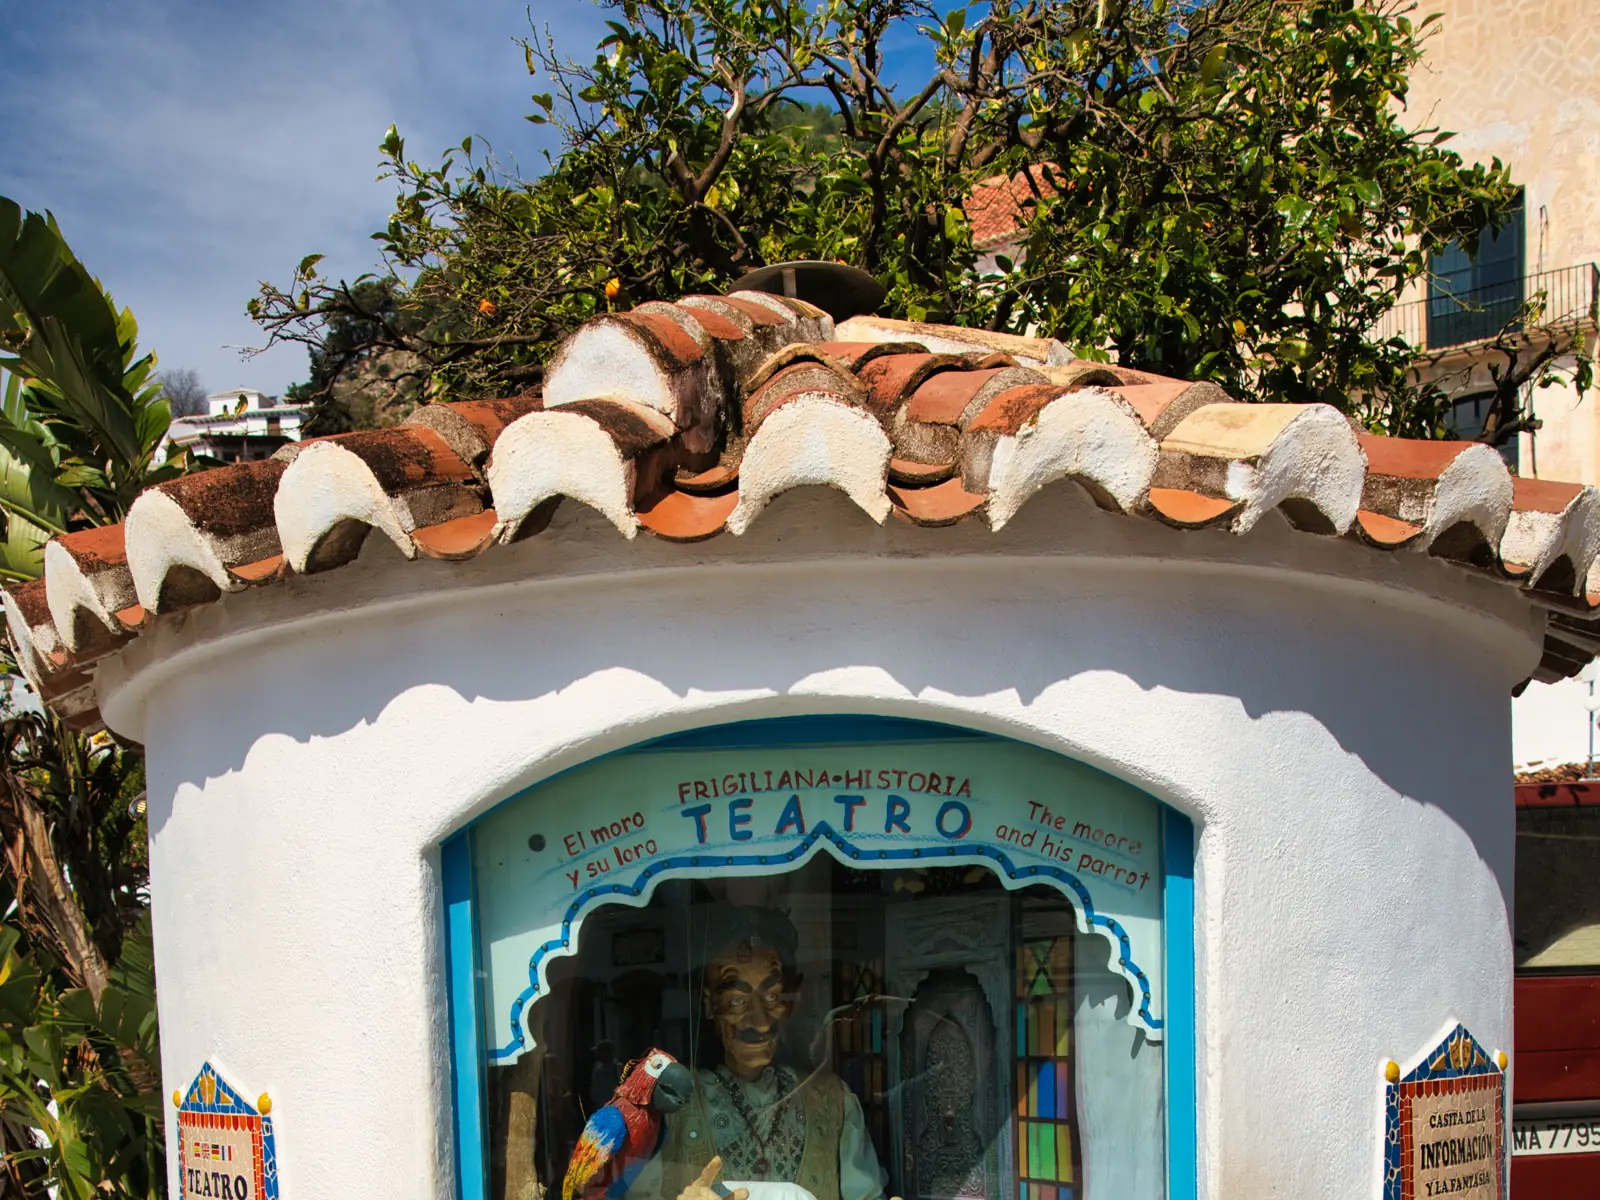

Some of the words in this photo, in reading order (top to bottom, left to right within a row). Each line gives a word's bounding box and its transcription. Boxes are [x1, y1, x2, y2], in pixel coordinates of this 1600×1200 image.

[563, 831, 587, 857] El
[591, 811, 645, 845] moro
[681, 795, 973, 844] TEATRO
[1028, 800, 1066, 830] The
[1073, 820, 1142, 856] moore
[566, 869, 579, 889] y
[587, 857, 611, 878] su
[613, 838, 658, 867] loro
[995, 824, 1037, 848] and
[1040, 833, 1073, 862] his
[1076, 853, 1151, 890] parrot
[1429, 1111, 1465, 1129] CASITA
[1465, 1109, 1476, 1124] DE
[1477, 1108, 1486, 1121] LA
[1512, 1125, 1542, 1151] MA
[1420, 1126, 1493, 1170] INFORMACIÓN
[188, 1168, 248, 1200] TEATRO
[1425, 1180, 1433, 1197] Y
[1434, 1179, 1449, 1195] LA
